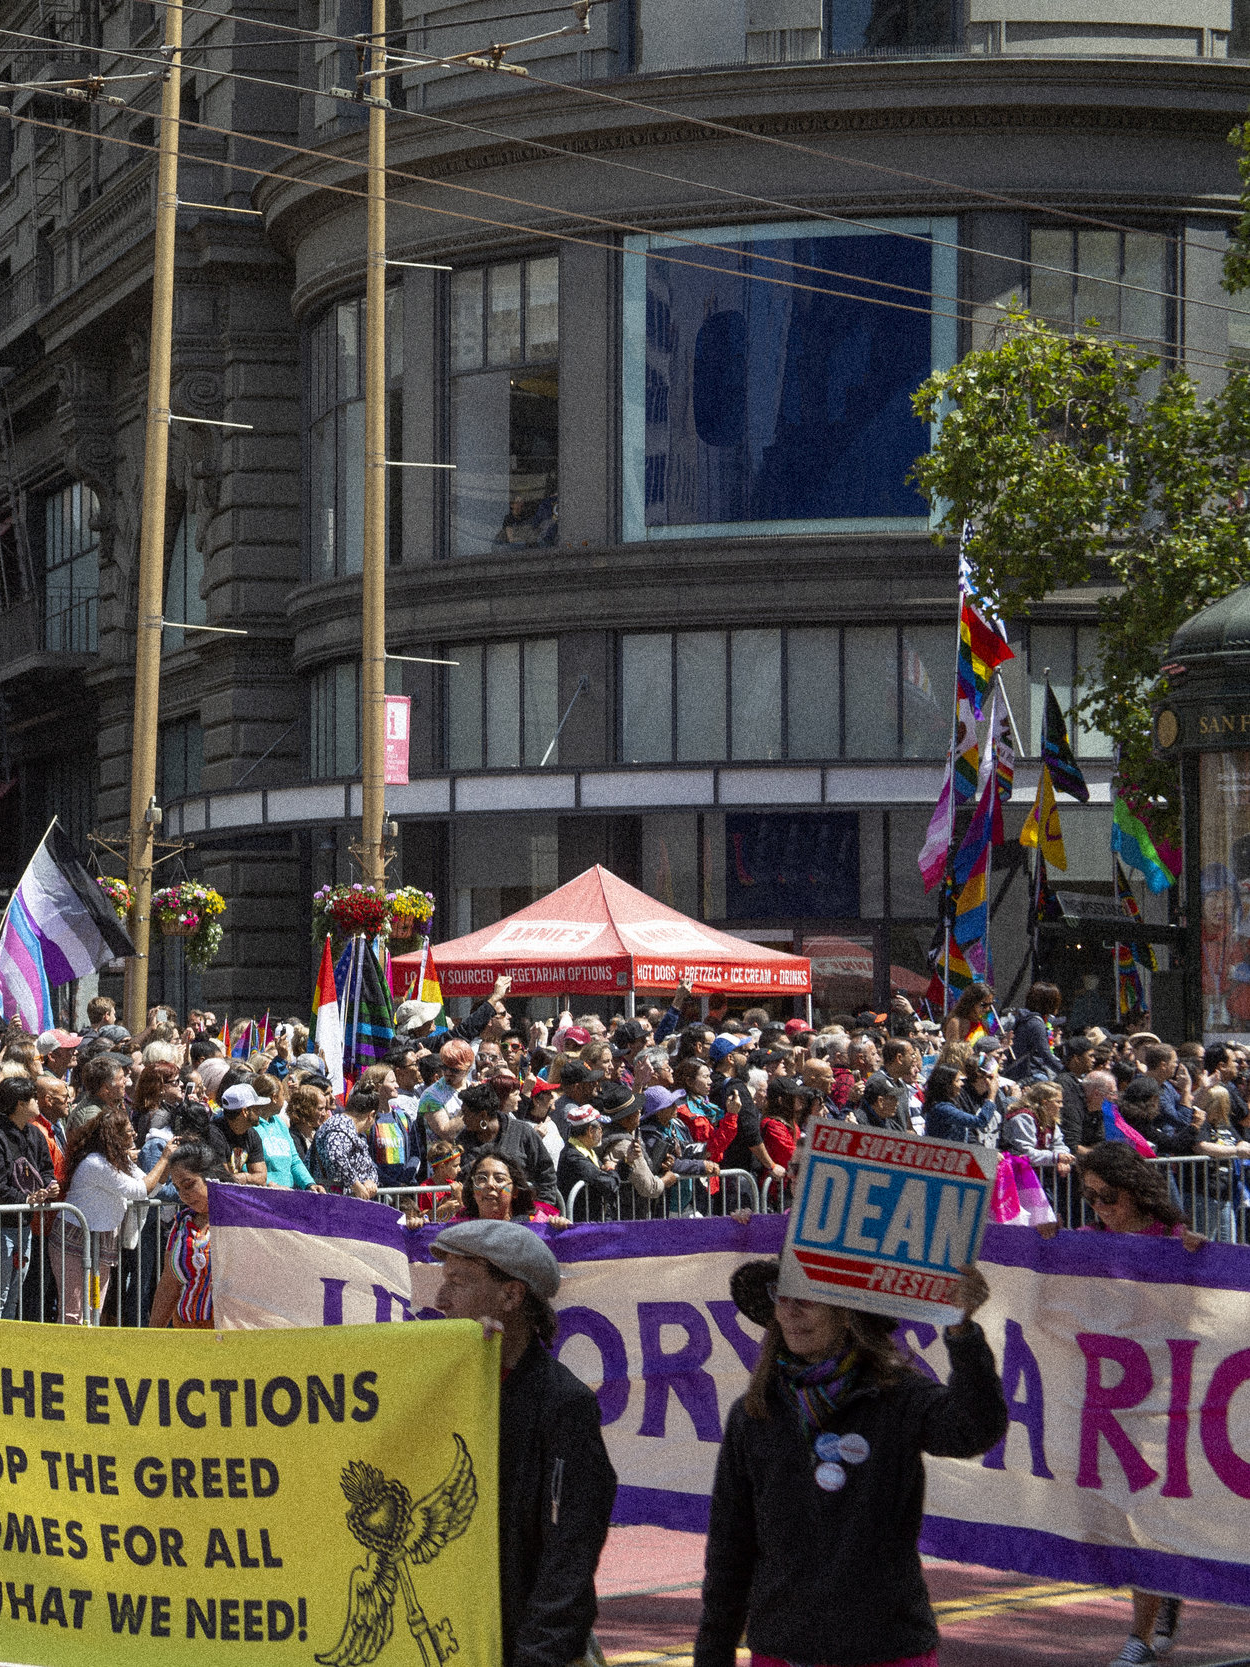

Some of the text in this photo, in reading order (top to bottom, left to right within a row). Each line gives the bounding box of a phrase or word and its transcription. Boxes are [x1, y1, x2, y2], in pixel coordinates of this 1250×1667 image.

[1199, 715, 1235, 734] SAN
[502, 927, 591, 943] ANNIE'S
[449, 969, 494, 984] SOURCED
[504, 966, 566, 983] VEGETARIAN
[567, 965, 613, 981] OPTIONS
[637, 964, 808, 985] HOT DOGS PRETZELS ICE CREAM DRINKS
[814, 1128, 972, 1174] FOR SUPERVISOR
[800, 1161, 980, 1269] DEAN
[85, 1370, 380, 1429] EVICTIONS
[40, 1450, 120, 1496] THE
[133, 1456, 281, 1499] GREED
[100, 1523, 188, 1569] FOR
[204, 1527, 283, 1569] ALL
[108, 1592, 172, 1636] WE
[185, 1596, 308, 1643] NEED!
